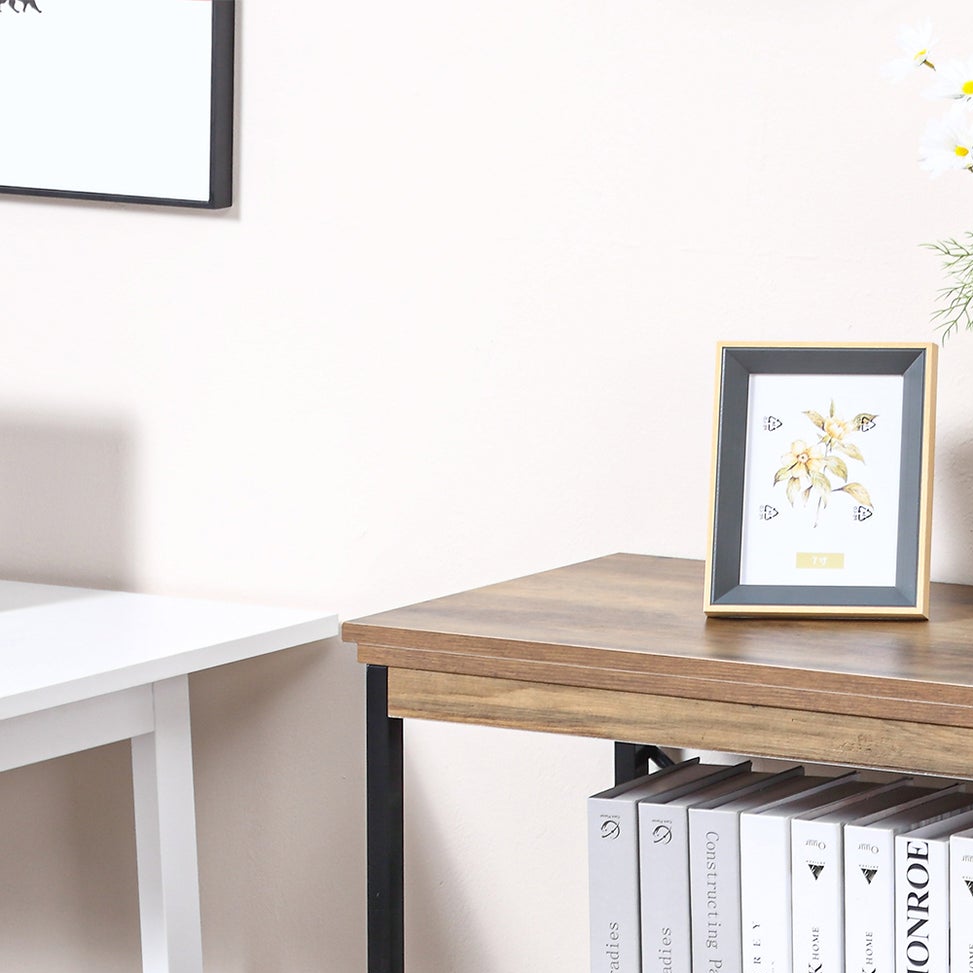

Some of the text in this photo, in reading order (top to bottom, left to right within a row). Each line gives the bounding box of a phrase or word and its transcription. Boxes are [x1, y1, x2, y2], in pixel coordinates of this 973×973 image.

[705, 831, 720, 951] Constructing
[811, 926, 821, 961] HOME
[865, 931, 874, 965] HOME
